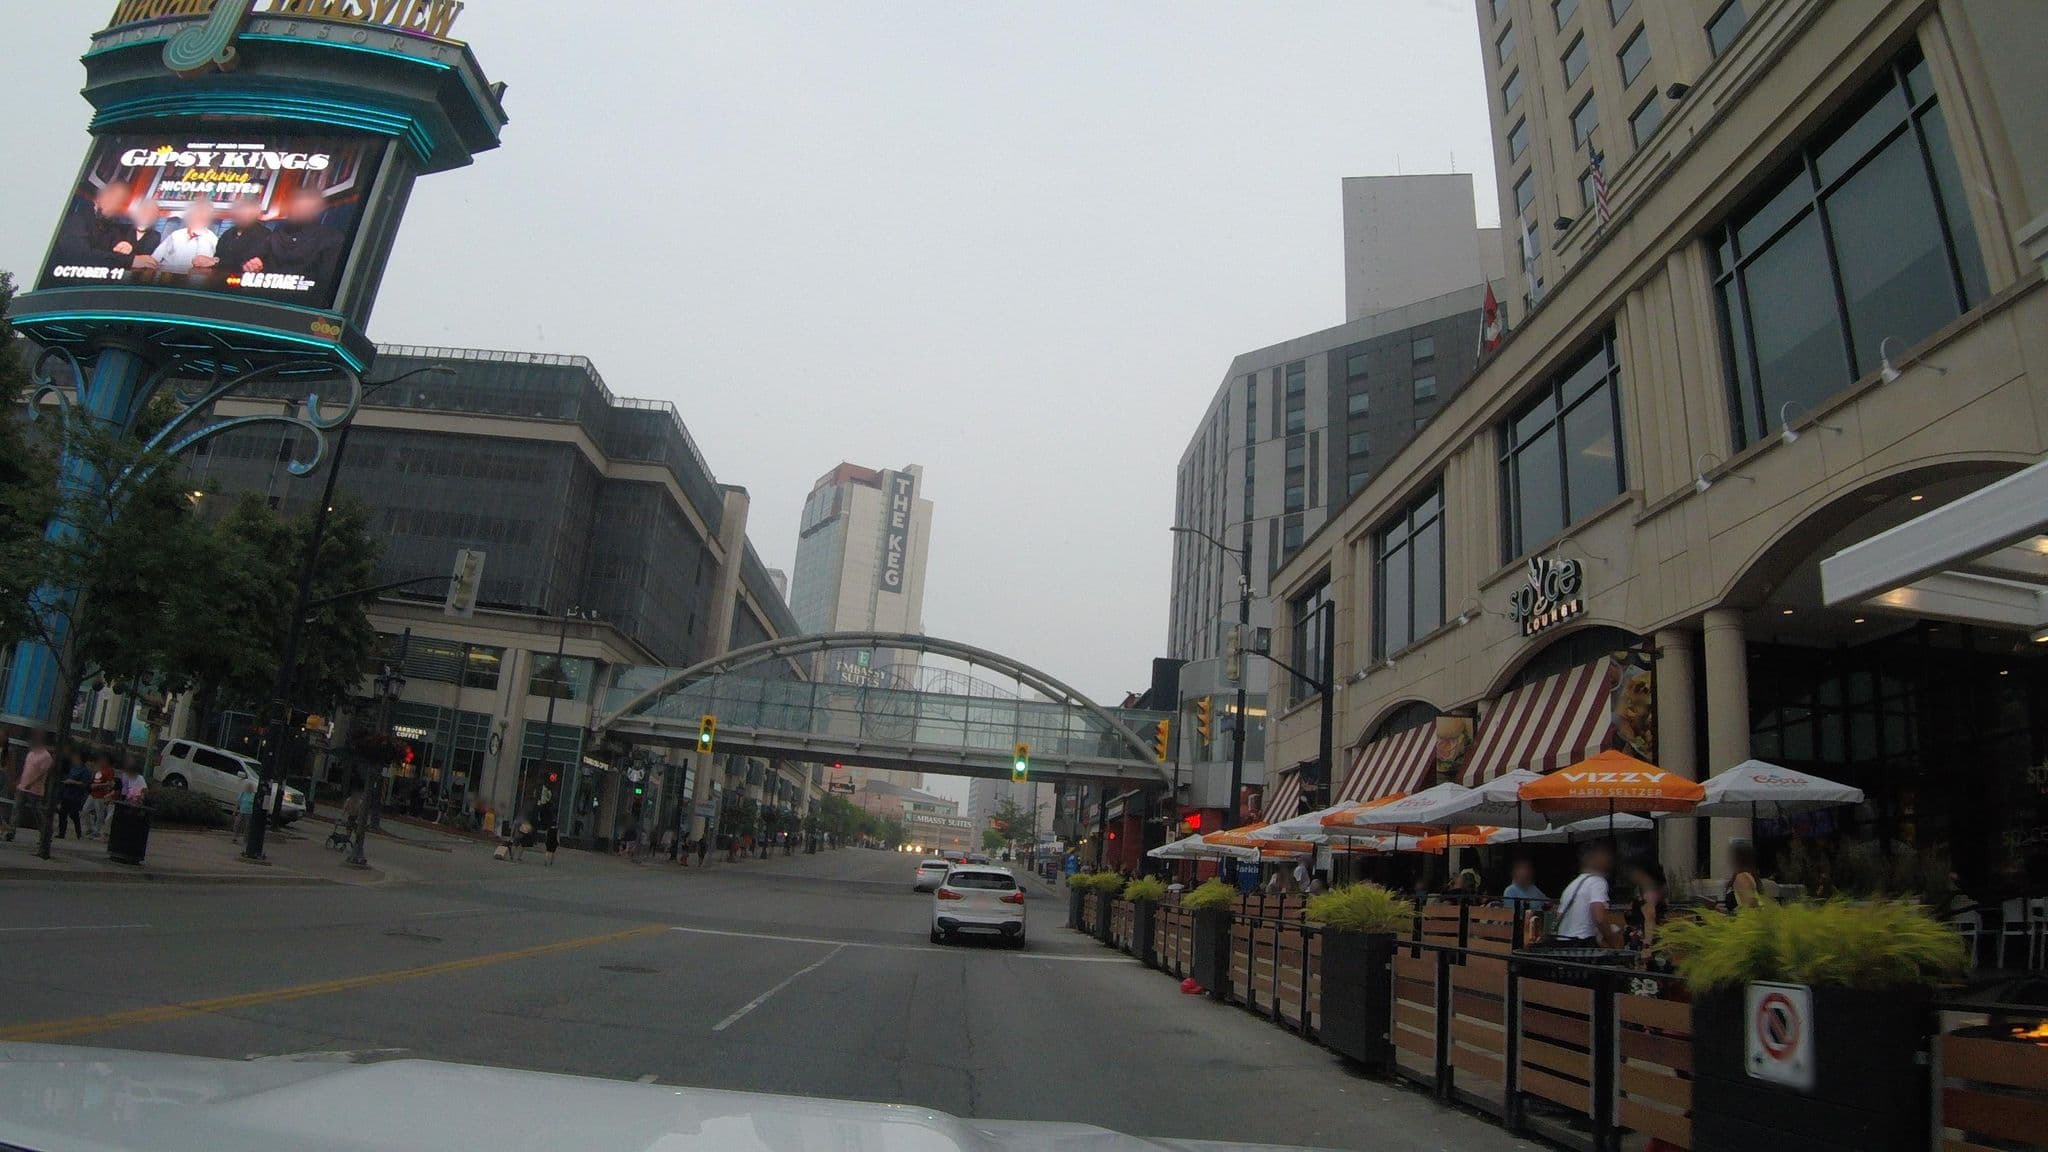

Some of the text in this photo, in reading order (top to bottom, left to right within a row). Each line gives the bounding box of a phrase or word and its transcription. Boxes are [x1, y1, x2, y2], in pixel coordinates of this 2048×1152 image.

[255, 20, 447, 60] RESORT
[121, 147, 330, 170] GIPSY KINGS
[182, 168, 254, 182] featuring
[160, 180, 261, 193] NICOLAS REYES
[53, 266, 125, 280] OCTOBER 11
[885, 479, 912, 586] THE KEG
[1527, 599, 1579, 635] LOUNGE
[1562, 772, 1666, 783] VIZZY
[1569, 788, 1662, 797] HARD SELTZER
